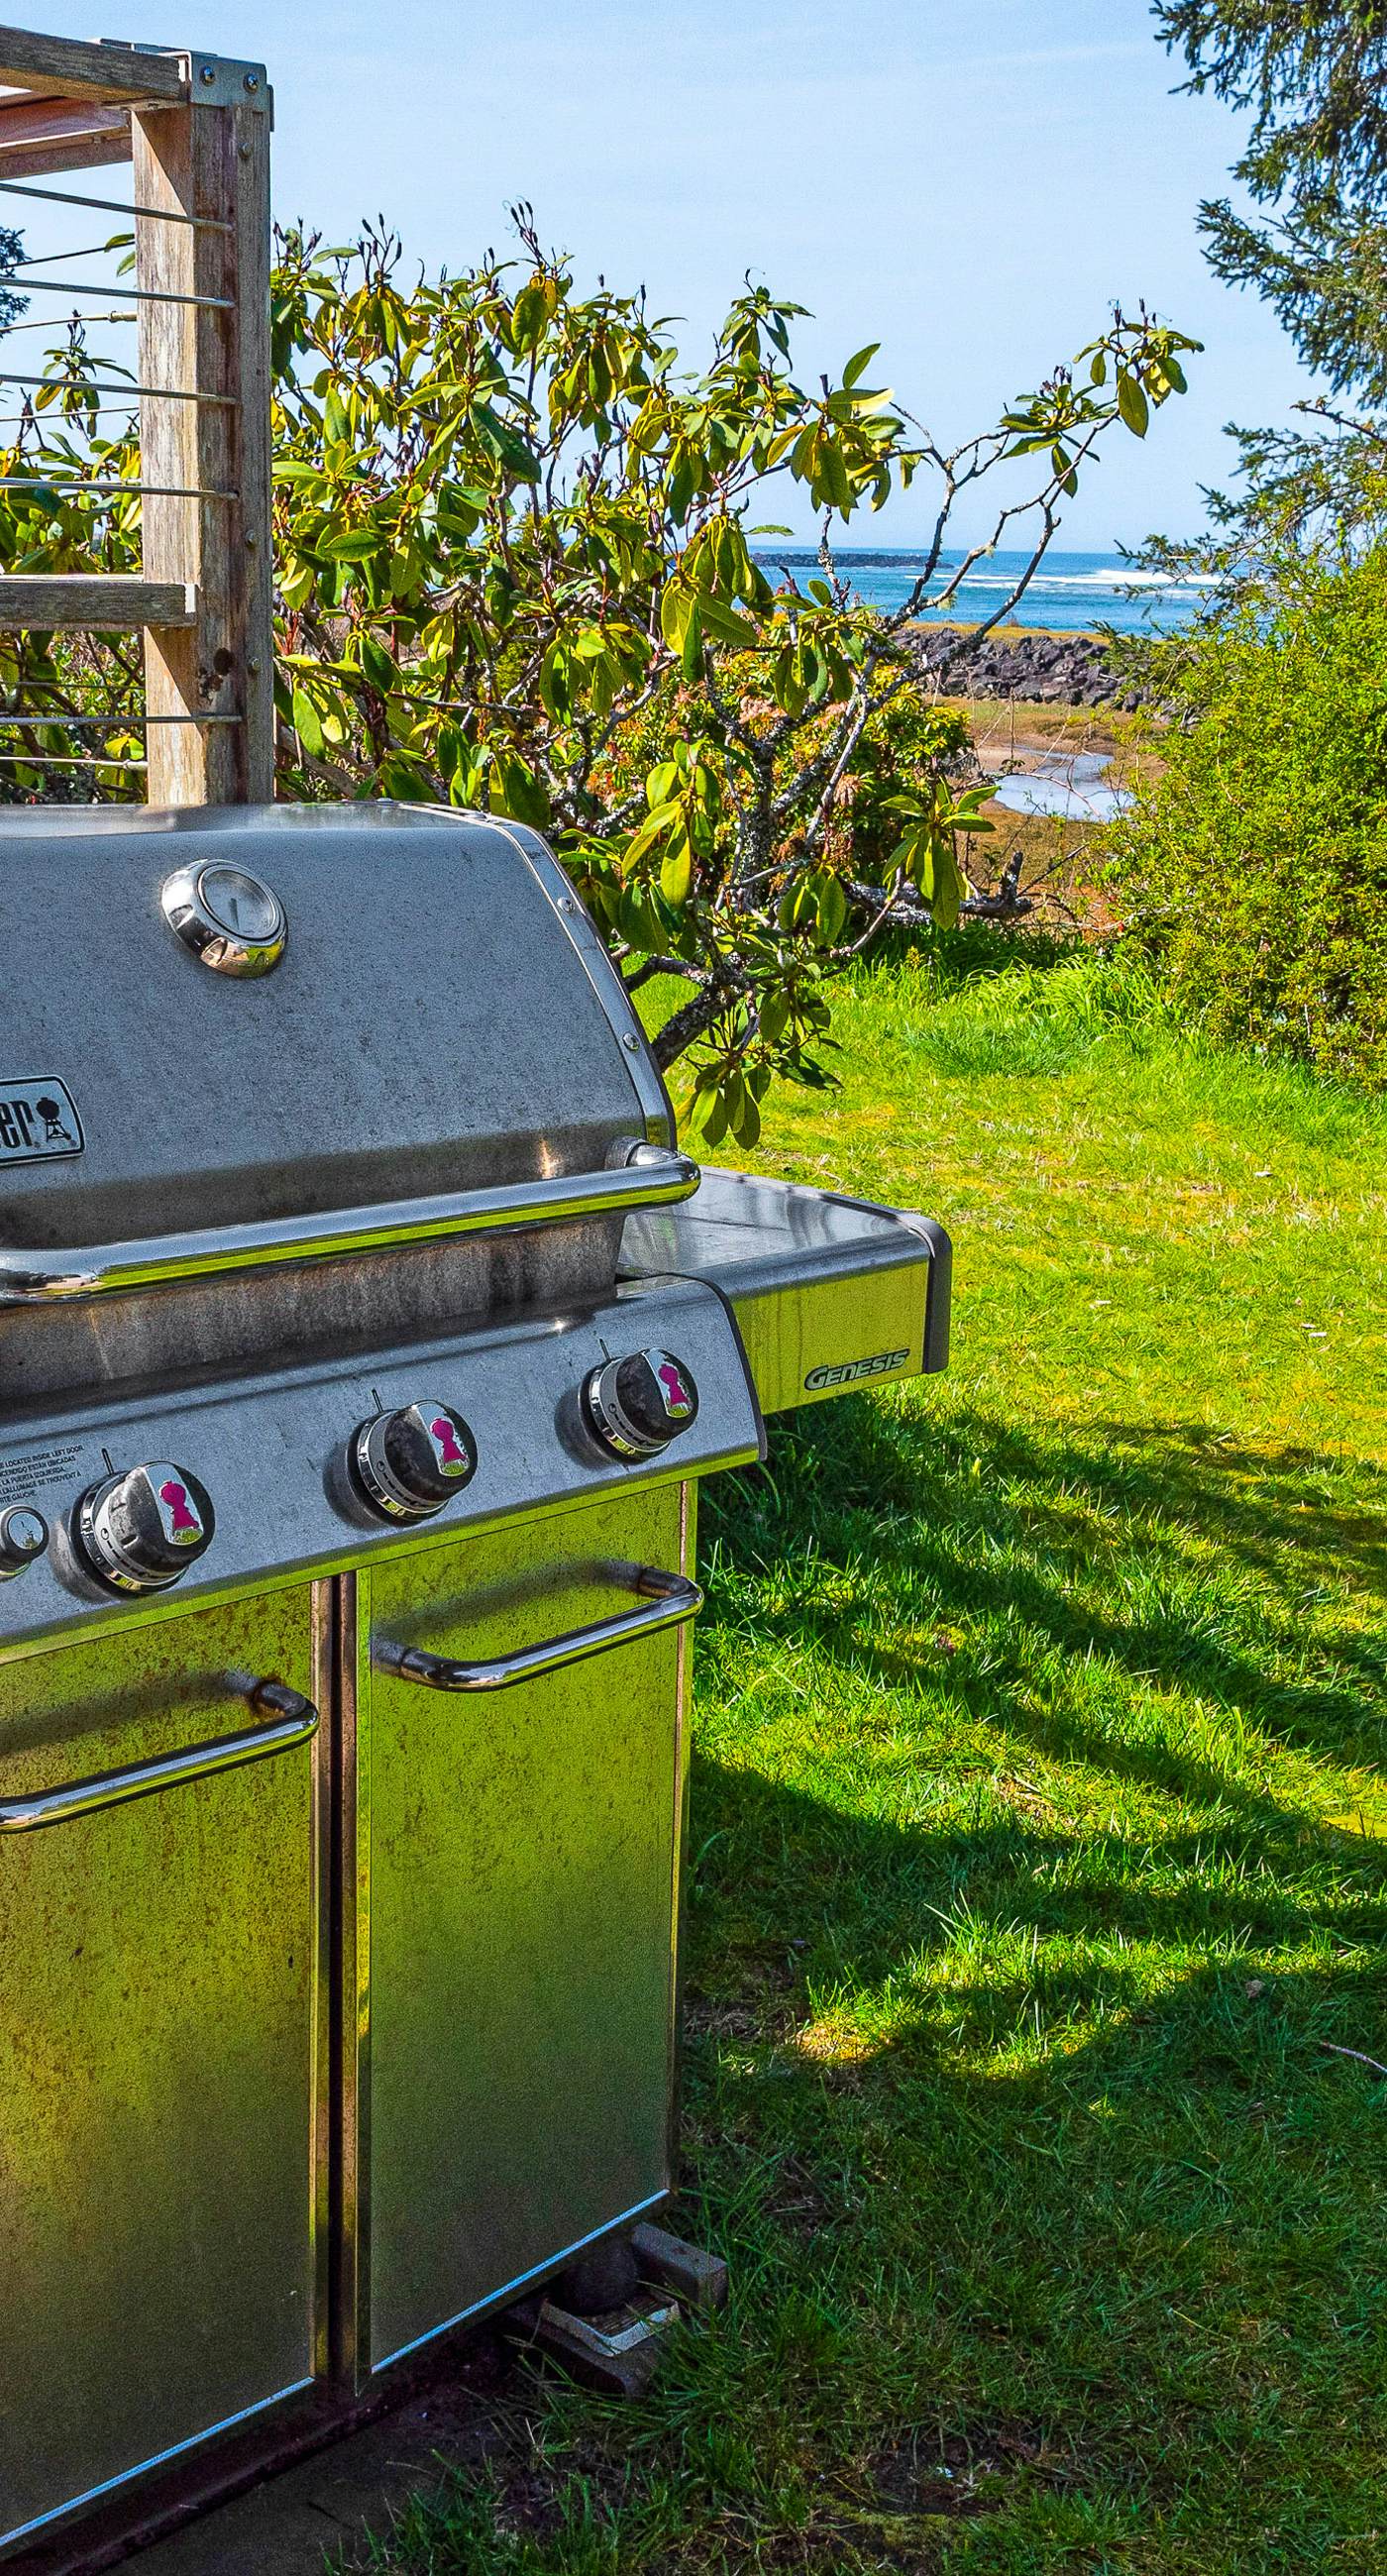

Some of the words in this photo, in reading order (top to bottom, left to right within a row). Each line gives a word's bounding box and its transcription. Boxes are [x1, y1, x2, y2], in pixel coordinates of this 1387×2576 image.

[803, 1347, 910, 1391] GENESIS
[5, 1456, 32, 1467] LOCATED
[32, 1452, 52, 1461] INSIDE
[52, 1449, 66, 1457] LEFT
[47, 1454, 76, 1466] UBICADAS
[11, 1473, 34, 1483] PUERTA
[47, 1471, 76, 1484] TROUVENT
